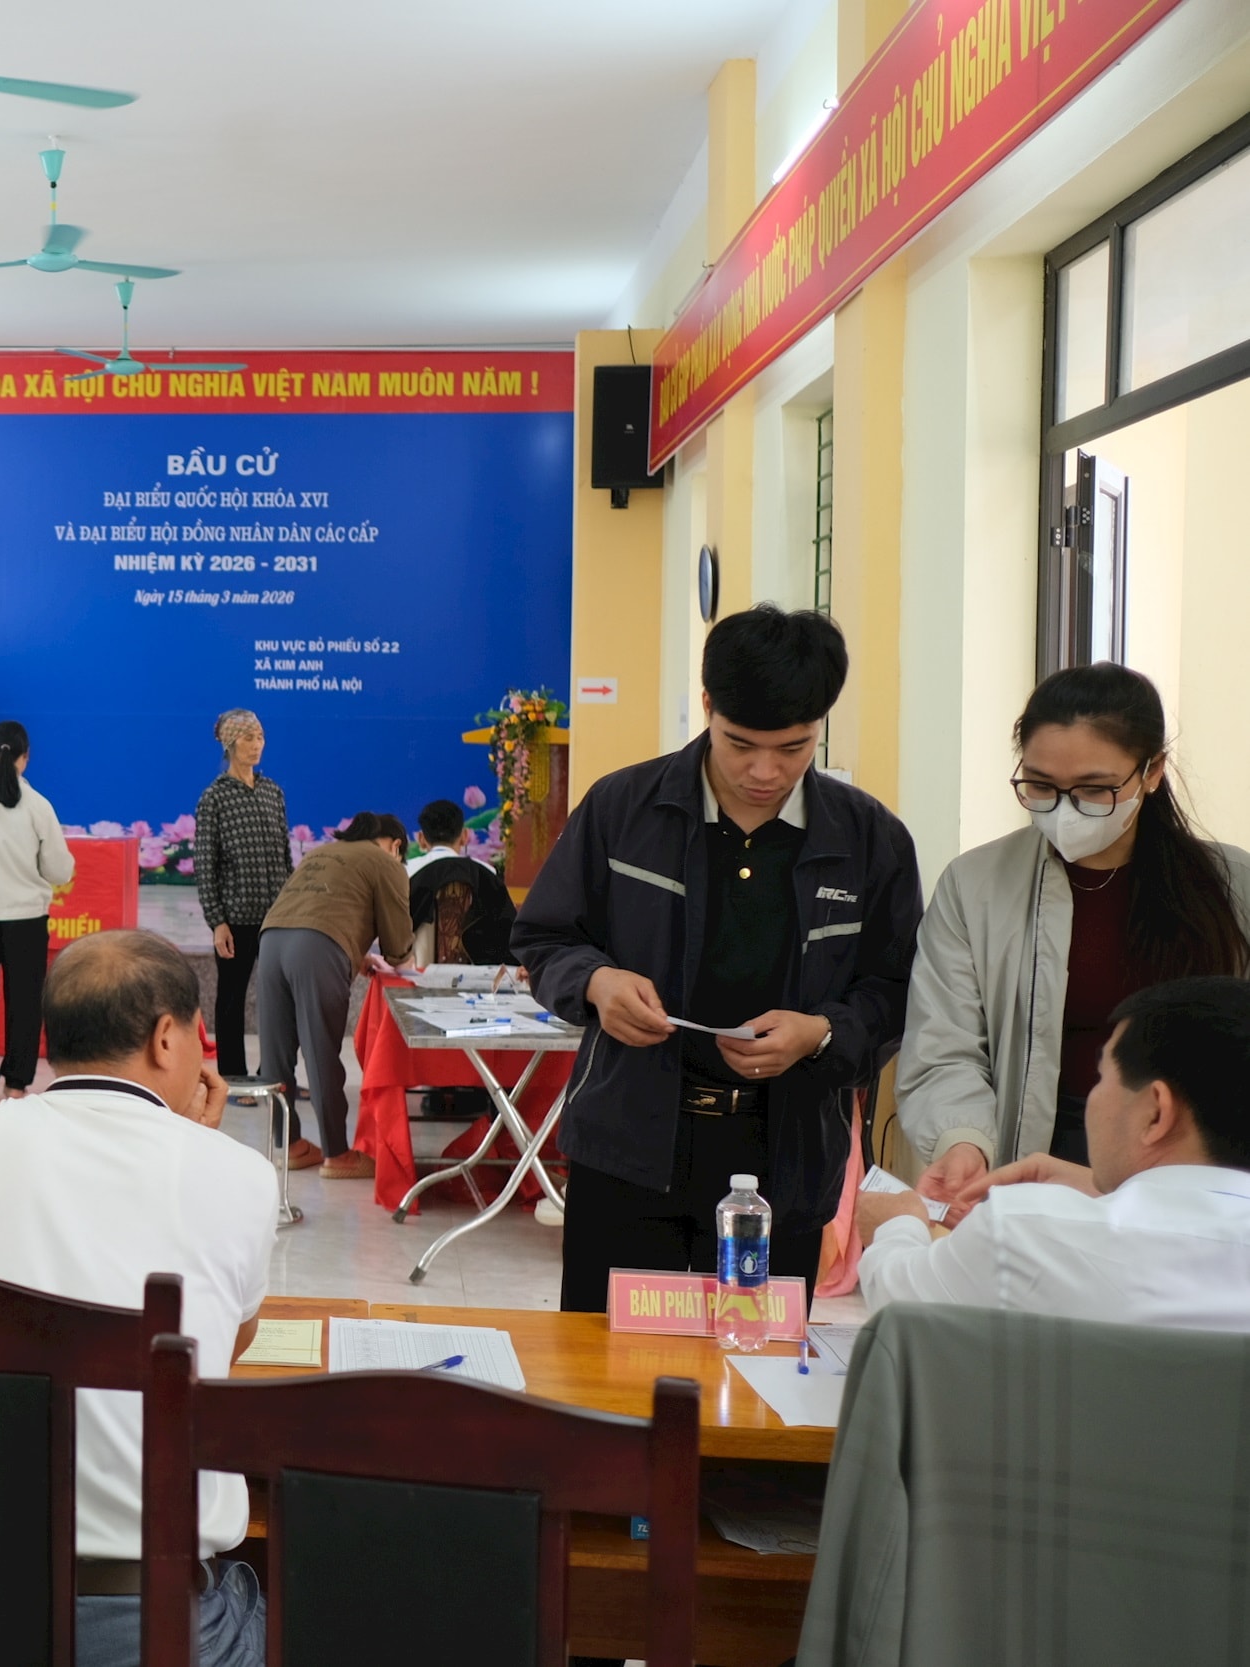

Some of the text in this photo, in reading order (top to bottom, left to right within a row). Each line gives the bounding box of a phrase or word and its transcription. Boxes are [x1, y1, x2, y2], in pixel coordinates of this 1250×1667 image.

[744, 253, 760, 339] NHÀ
[763, 223, 786, 321] NƯỚC
[789, 195, 815, 294] PHÁP
[819, 136, 856, 270] QUYỀN
[860, 115, 878, 222] XÃ
[882, 84, 906, 207] HỘI
[911, 13, 945, 168] CHỦ
[23, 370, 57, 397] XÃ
[63, 371, 105, 403] HỘI
[169, 369, 245, 397] NGHĨA
[253, 368, 305, 402] VIỆT
[312, 372, 370, 397] NAM
[379, 367, 454, 397] MUÔN
[462, 366, 521, 396] NĂM
[167, 446, 279, 476] BẦU CỬ
[103, 482, 329, 511] ĐẠI BIỂU QUỐC HỘI KHÓA XVI
[54, 516, 379, 544] VÀ ĐẠI BIỂU HỘI ĐỒNG NHÂN DÂN CÁC CẤP
[114, 552, 175, 574] NHIỆM
[181, 552, 204, 571] KỲ
[210, 555, 256, 572] 2026
[274, 556, 318, 572] 2031
[134, 589, 295, 607] Ngày 15 tháng 3 năm 2026
[255, 636, 400, 654] KHU VỰC BỎ PHIẾU SỐ 22
[255, 657, 323, 671] XÃ KIM ANH
[254, 675, 362, 694] THÀNH PHỐ HÀ NỘI
[47, 912, 101, 939] PHIẾU
[630, 1284, 661, 1318] BÀN
[665, 1286, 703, 1319] PHÁT
